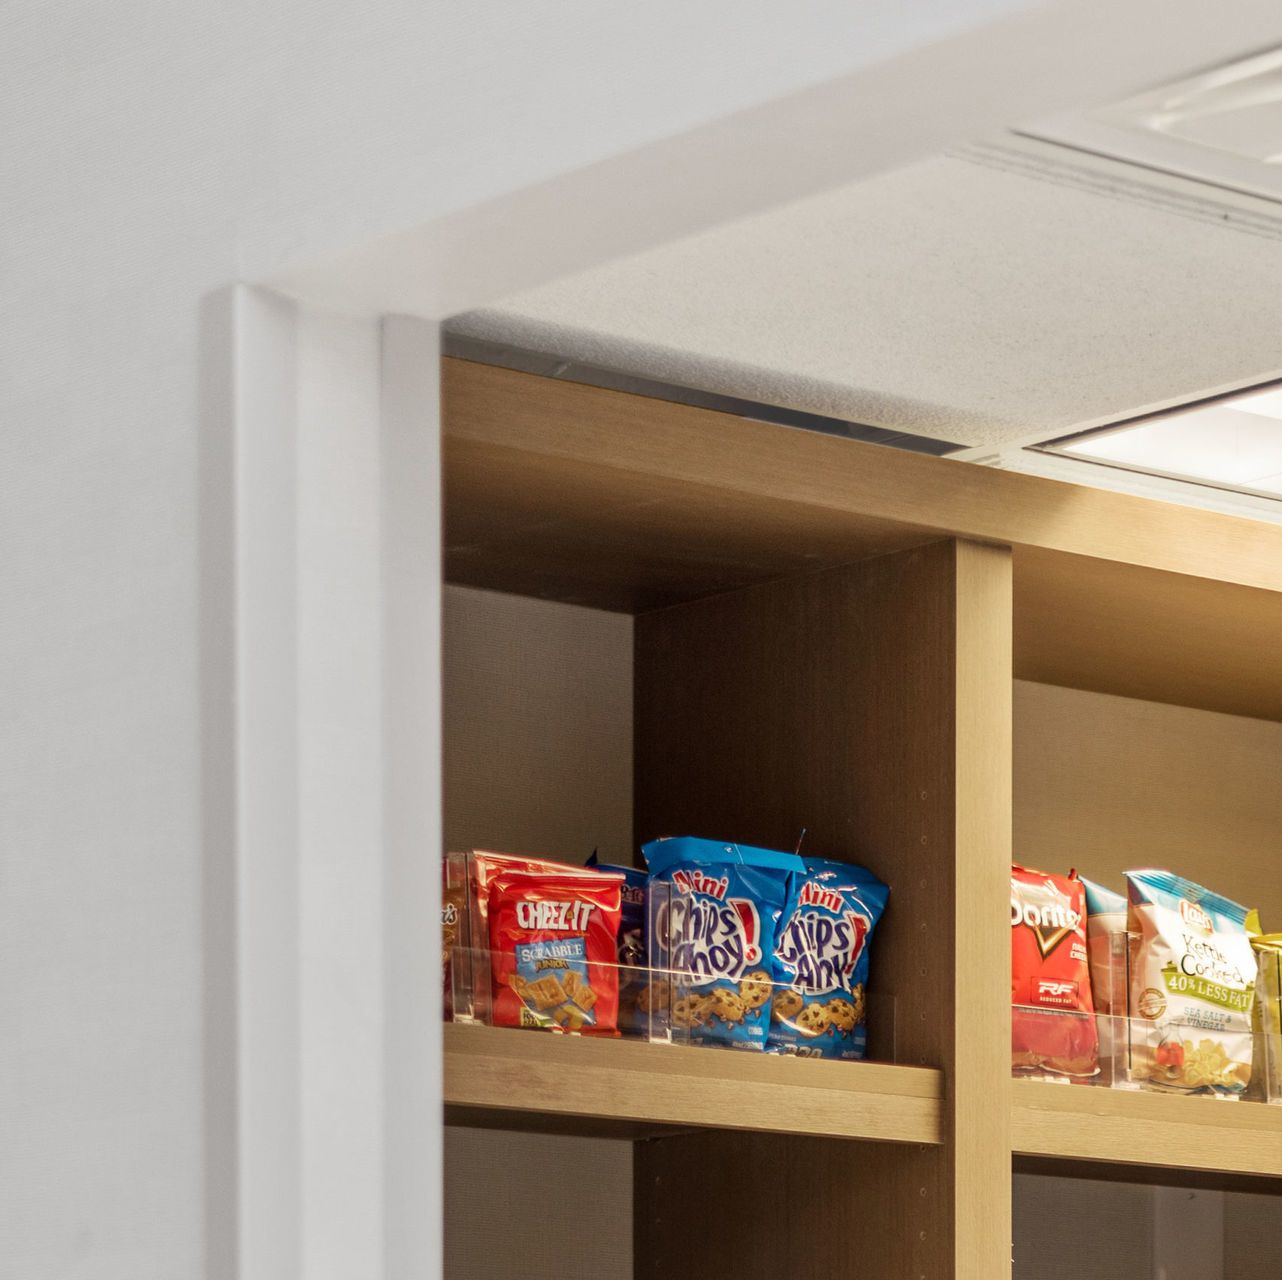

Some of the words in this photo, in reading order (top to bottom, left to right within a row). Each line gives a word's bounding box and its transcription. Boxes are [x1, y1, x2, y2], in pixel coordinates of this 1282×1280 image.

[521, 942, 583, 962] SCRABBLE
[1168, 976, 1196, 991] 40%
[1198, 981, 1228, 1002] LESS
[1229, 990, 1250, 1009] FAT
